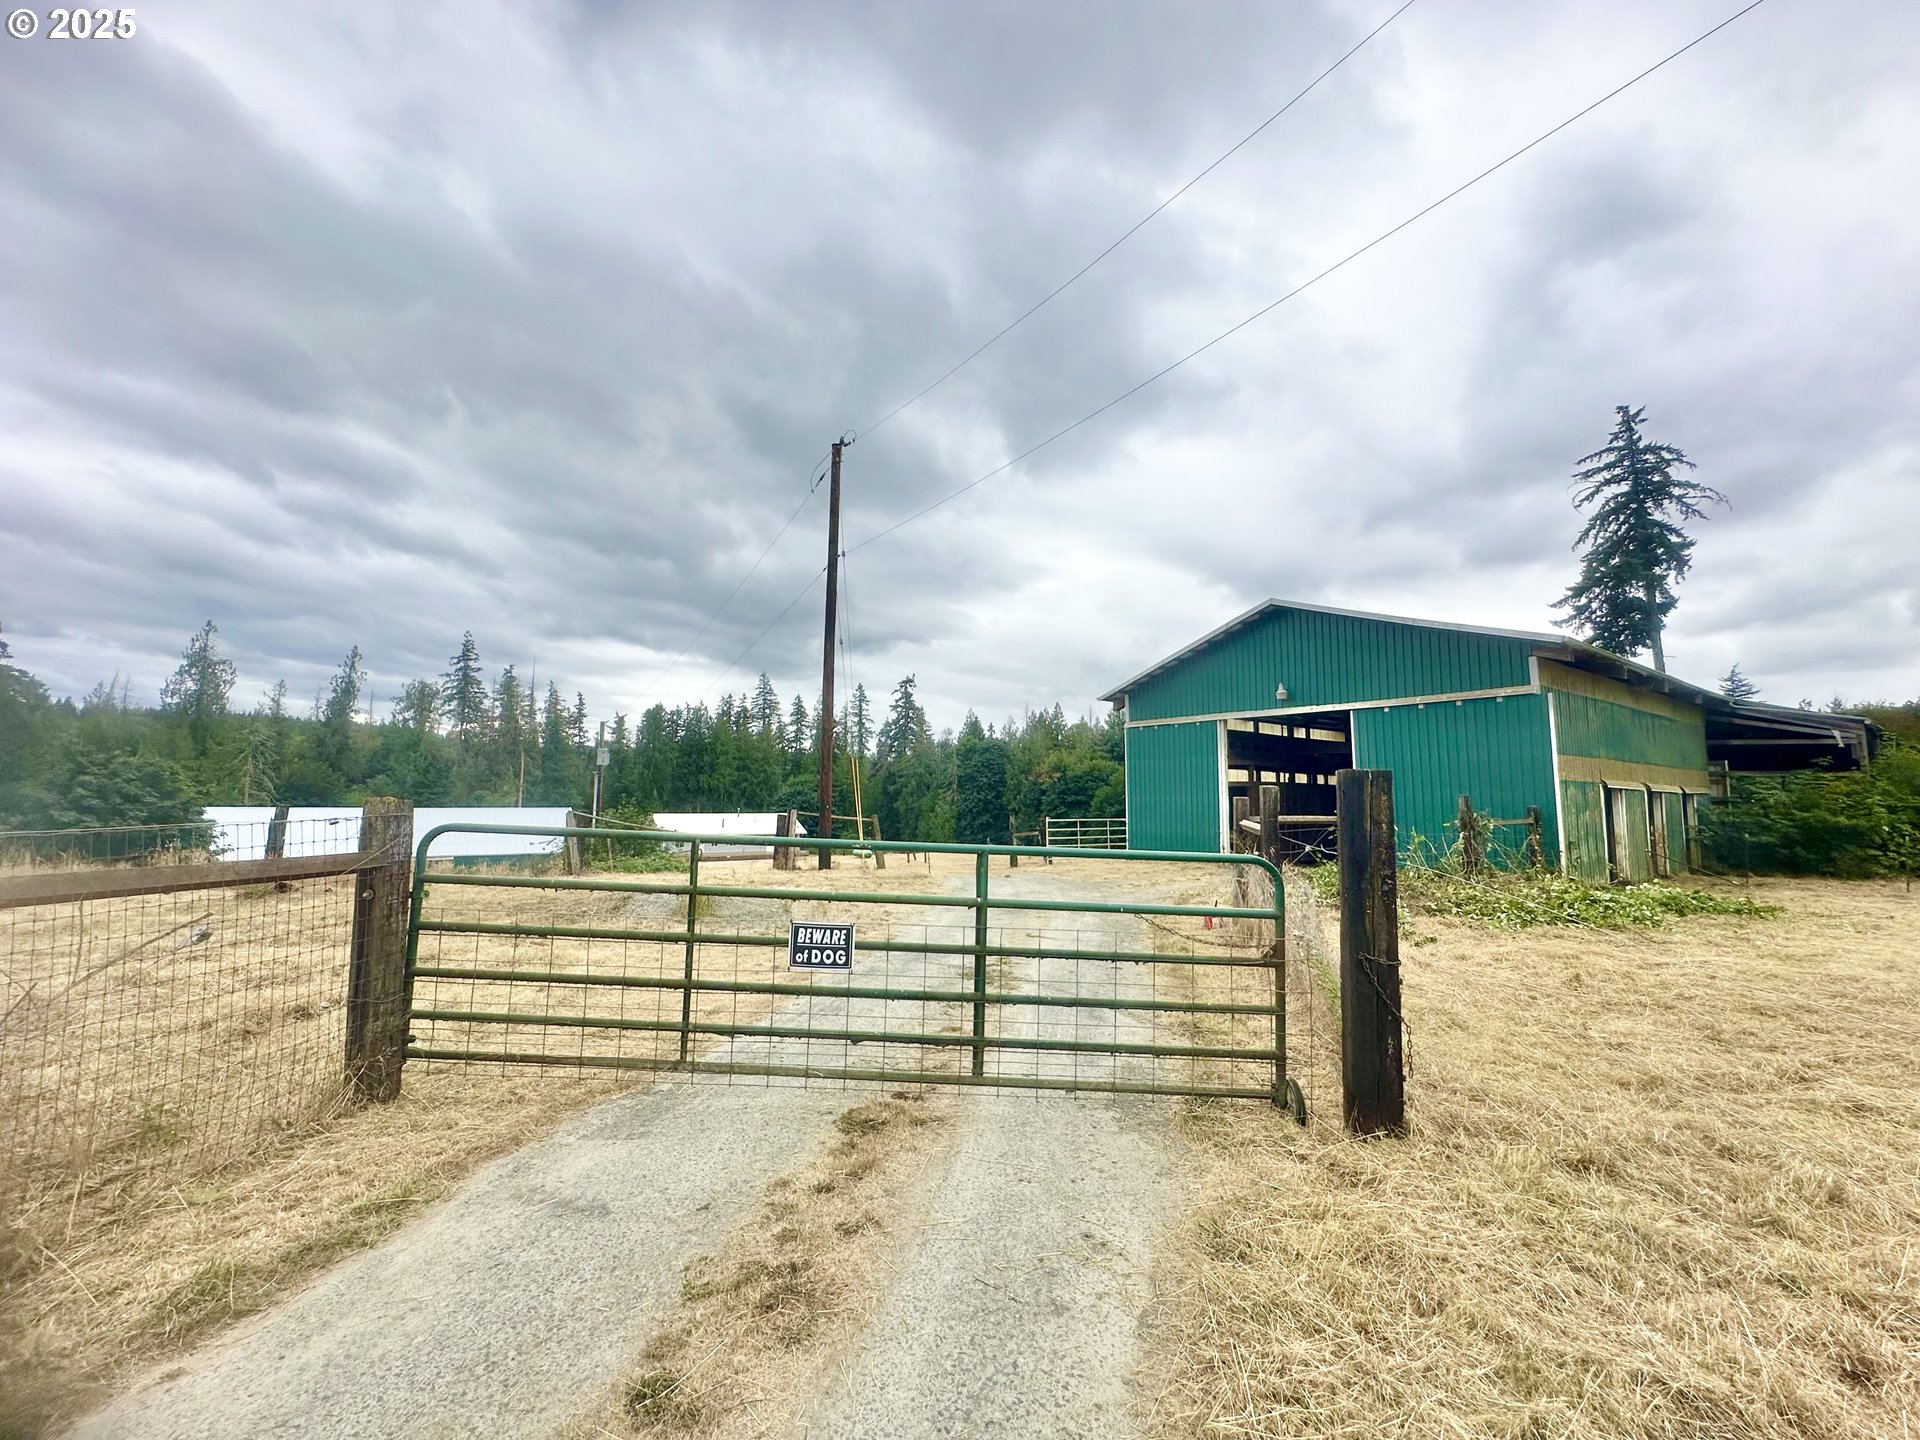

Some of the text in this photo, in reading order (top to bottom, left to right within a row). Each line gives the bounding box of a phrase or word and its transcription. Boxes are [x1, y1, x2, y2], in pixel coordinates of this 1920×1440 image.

[797, 927, 847, 945] BEWARE
[795, 949, 847, 964] of DOG
